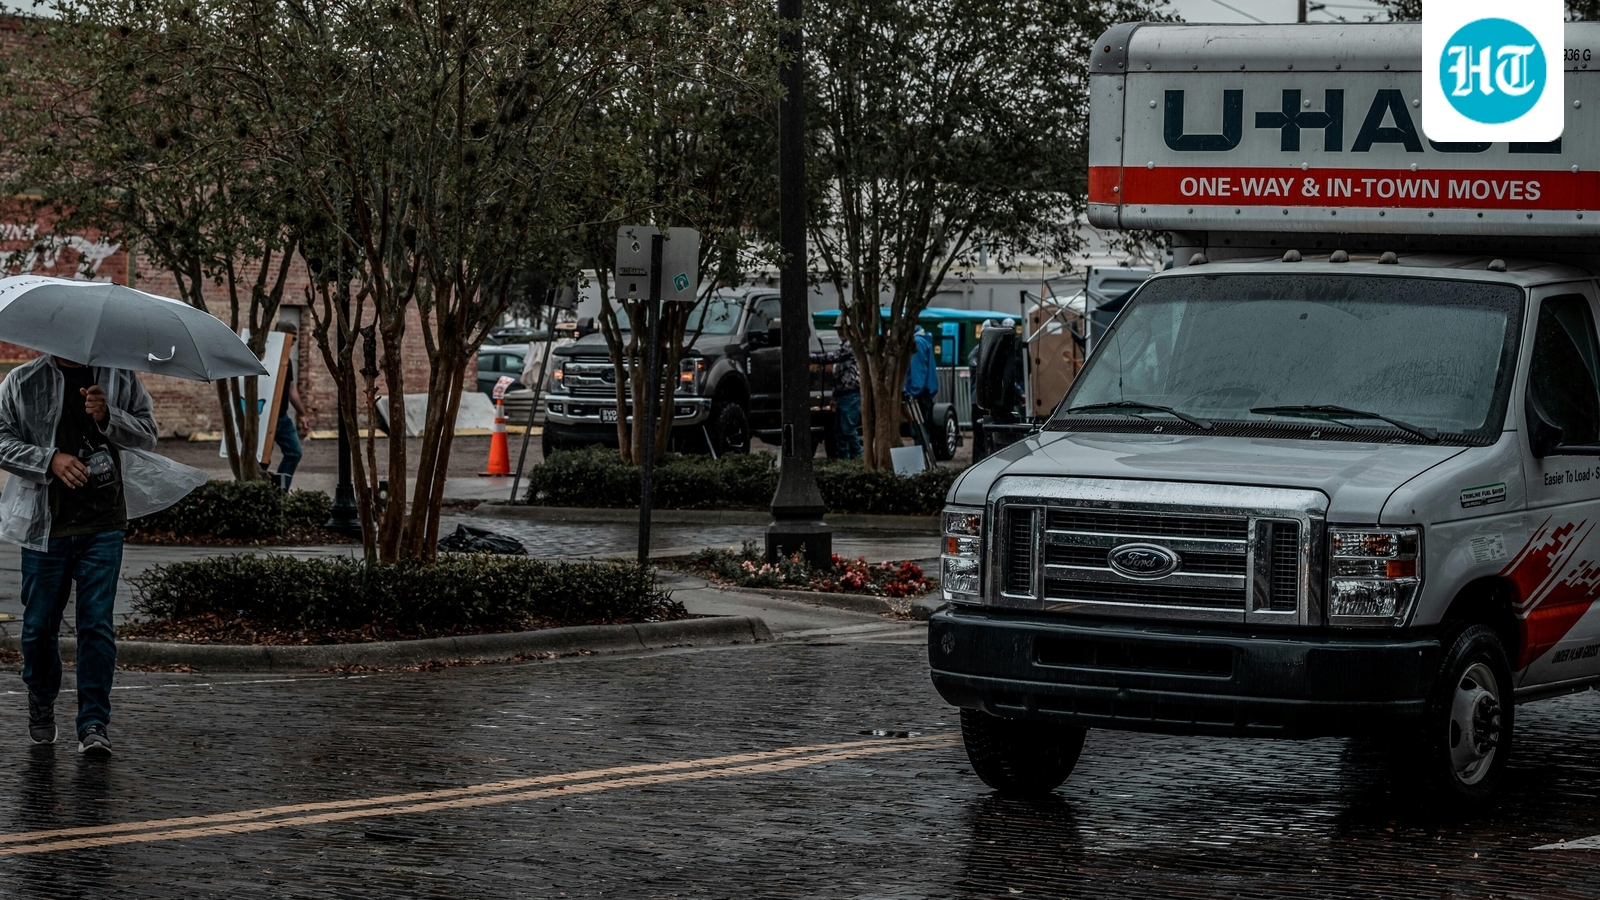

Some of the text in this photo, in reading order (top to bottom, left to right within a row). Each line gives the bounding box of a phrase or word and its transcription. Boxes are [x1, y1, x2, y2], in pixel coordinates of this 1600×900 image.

[1582, 48, 1591, 61] G
[1180, 177, 1541, 201] ONE-WAY & IN-TOWN MOVES
[91, 456, 104, 465] VIP
[98, 473, 111, 482] VIP
[1545, 472, 1564, 485] Easier
[1565, 470, 1573, 483] To
[1574, 467, 1590, 482] Load
[1122, 552, 1156, 568] Ford
